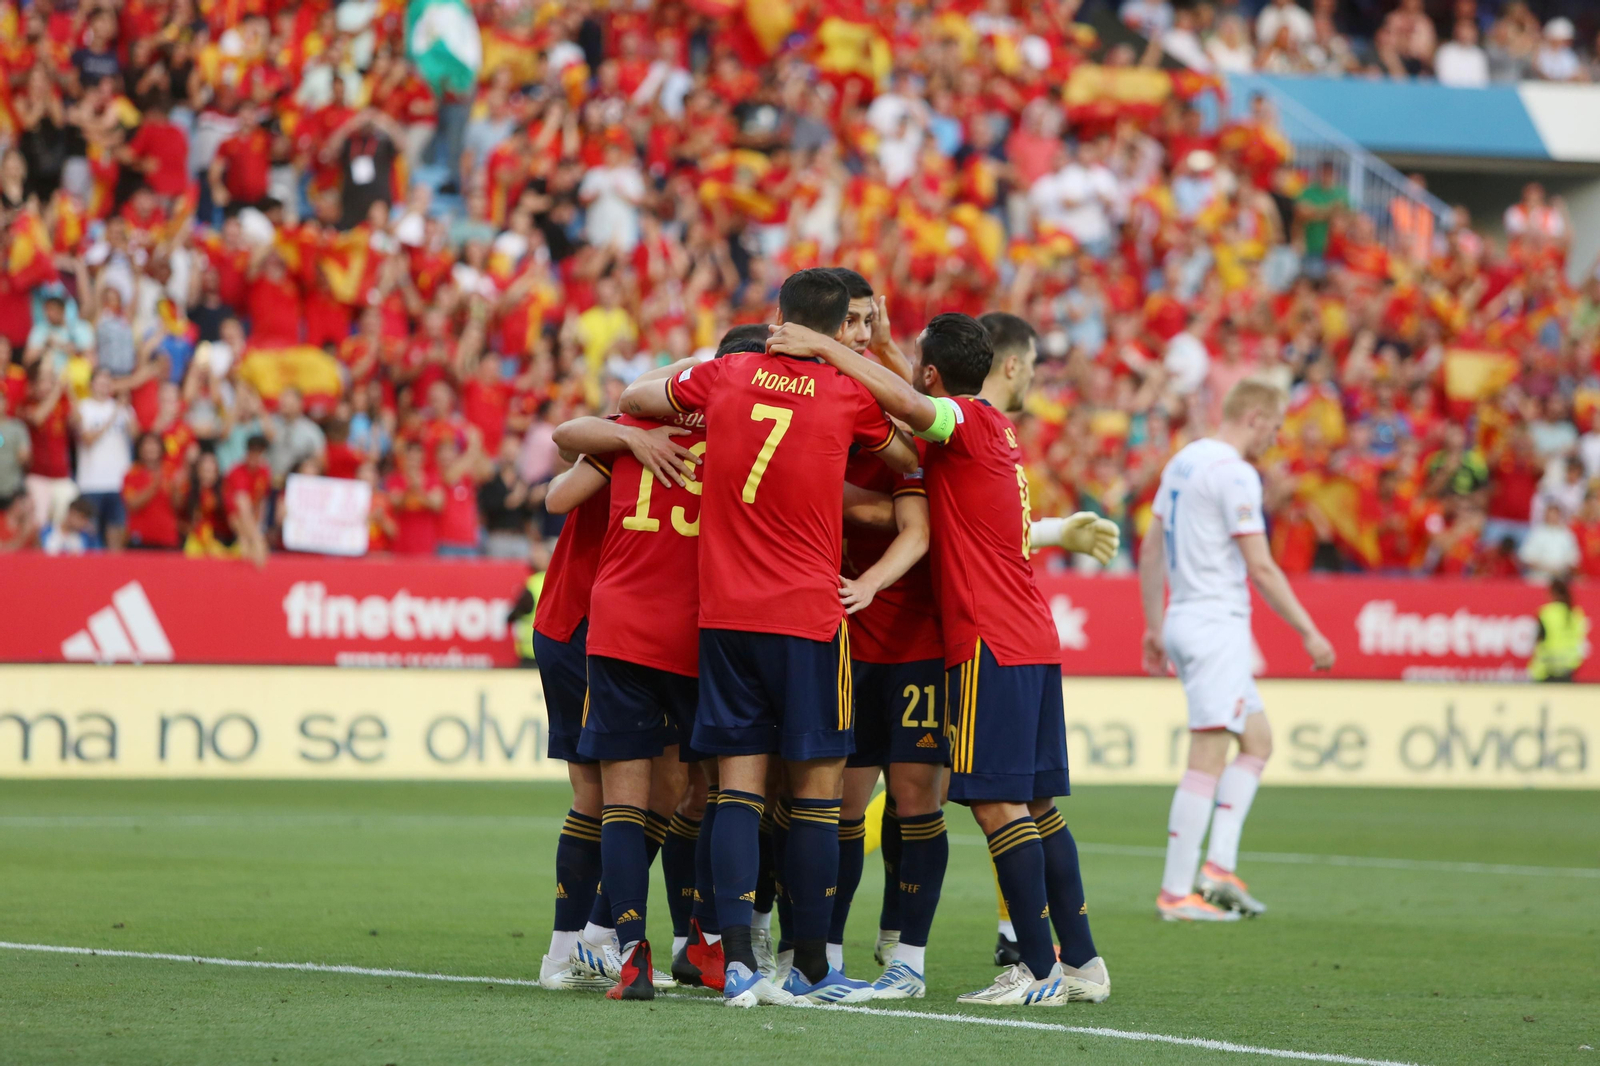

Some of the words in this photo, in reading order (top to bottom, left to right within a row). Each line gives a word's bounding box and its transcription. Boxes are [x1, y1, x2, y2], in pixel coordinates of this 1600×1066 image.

[751, 367, 815, 397] MORATA
[742, 403, 793, 504] 7
[1355, 599, 1591, 659] finetwo
[902, 684, 938, 728] 21
[158, 712, 260, 763] no
[298, 713, 389, 763] se
[1288, 721, 1367, 771] se
[1398, 701, 1588, 773] olvida
